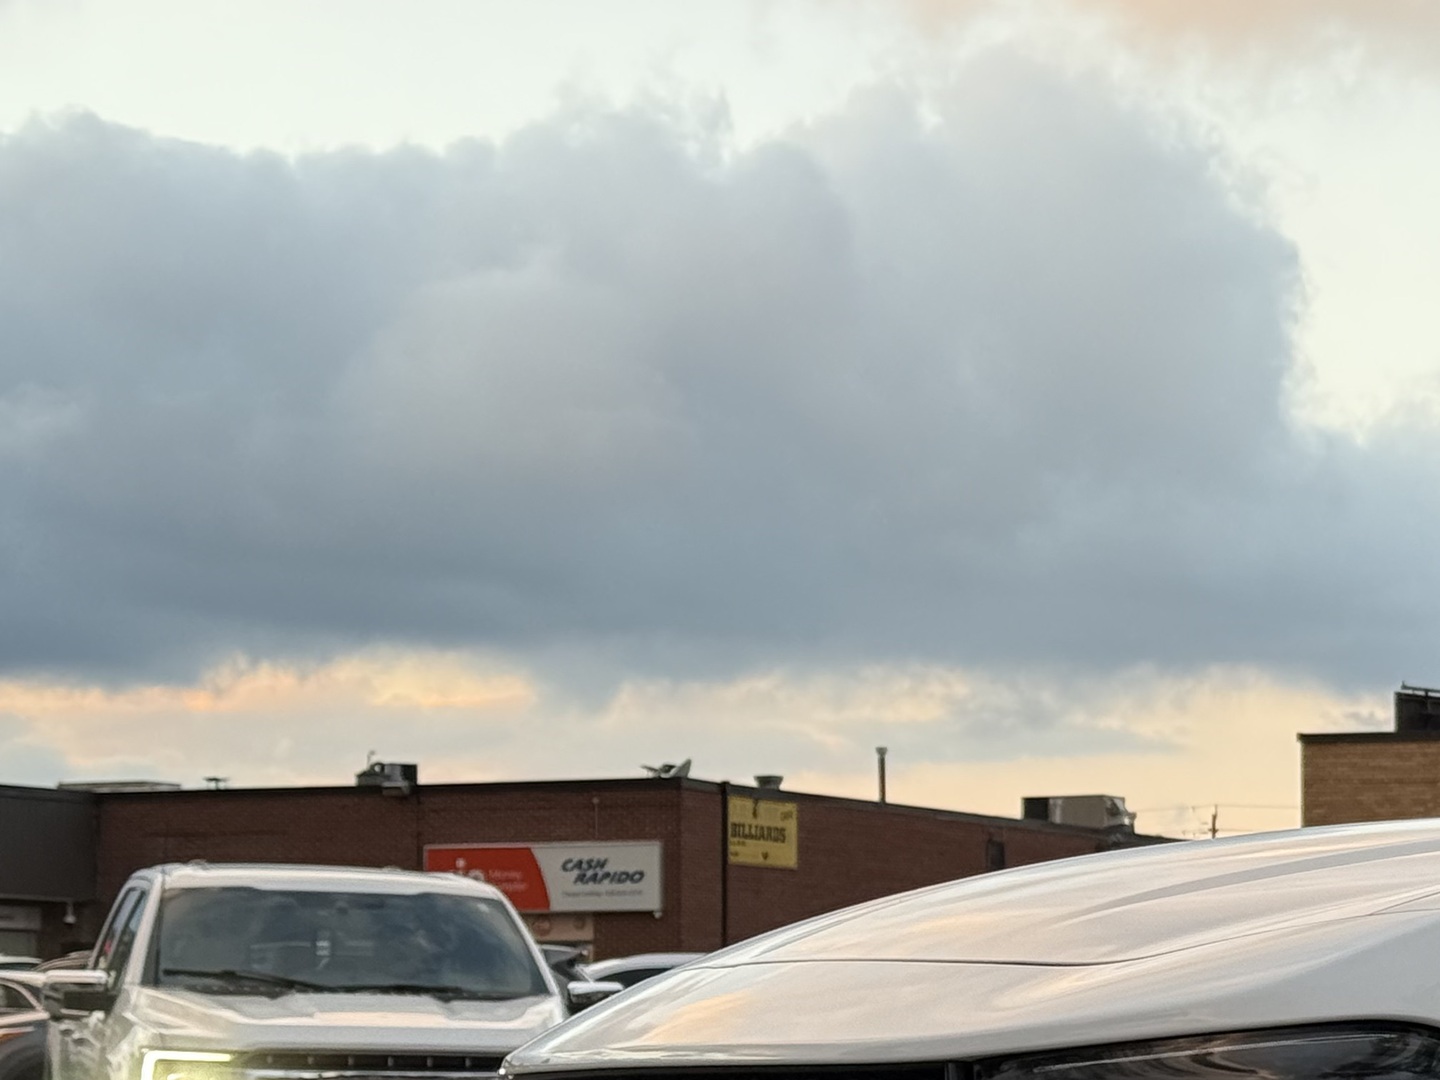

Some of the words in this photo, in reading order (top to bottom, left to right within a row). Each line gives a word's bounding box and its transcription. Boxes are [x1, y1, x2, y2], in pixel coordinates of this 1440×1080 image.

[730, 822, 786, 844] BILLIARDS
[561, 857, 608, 872] CASH
[573, 869, 645, 885] RAPIDO
